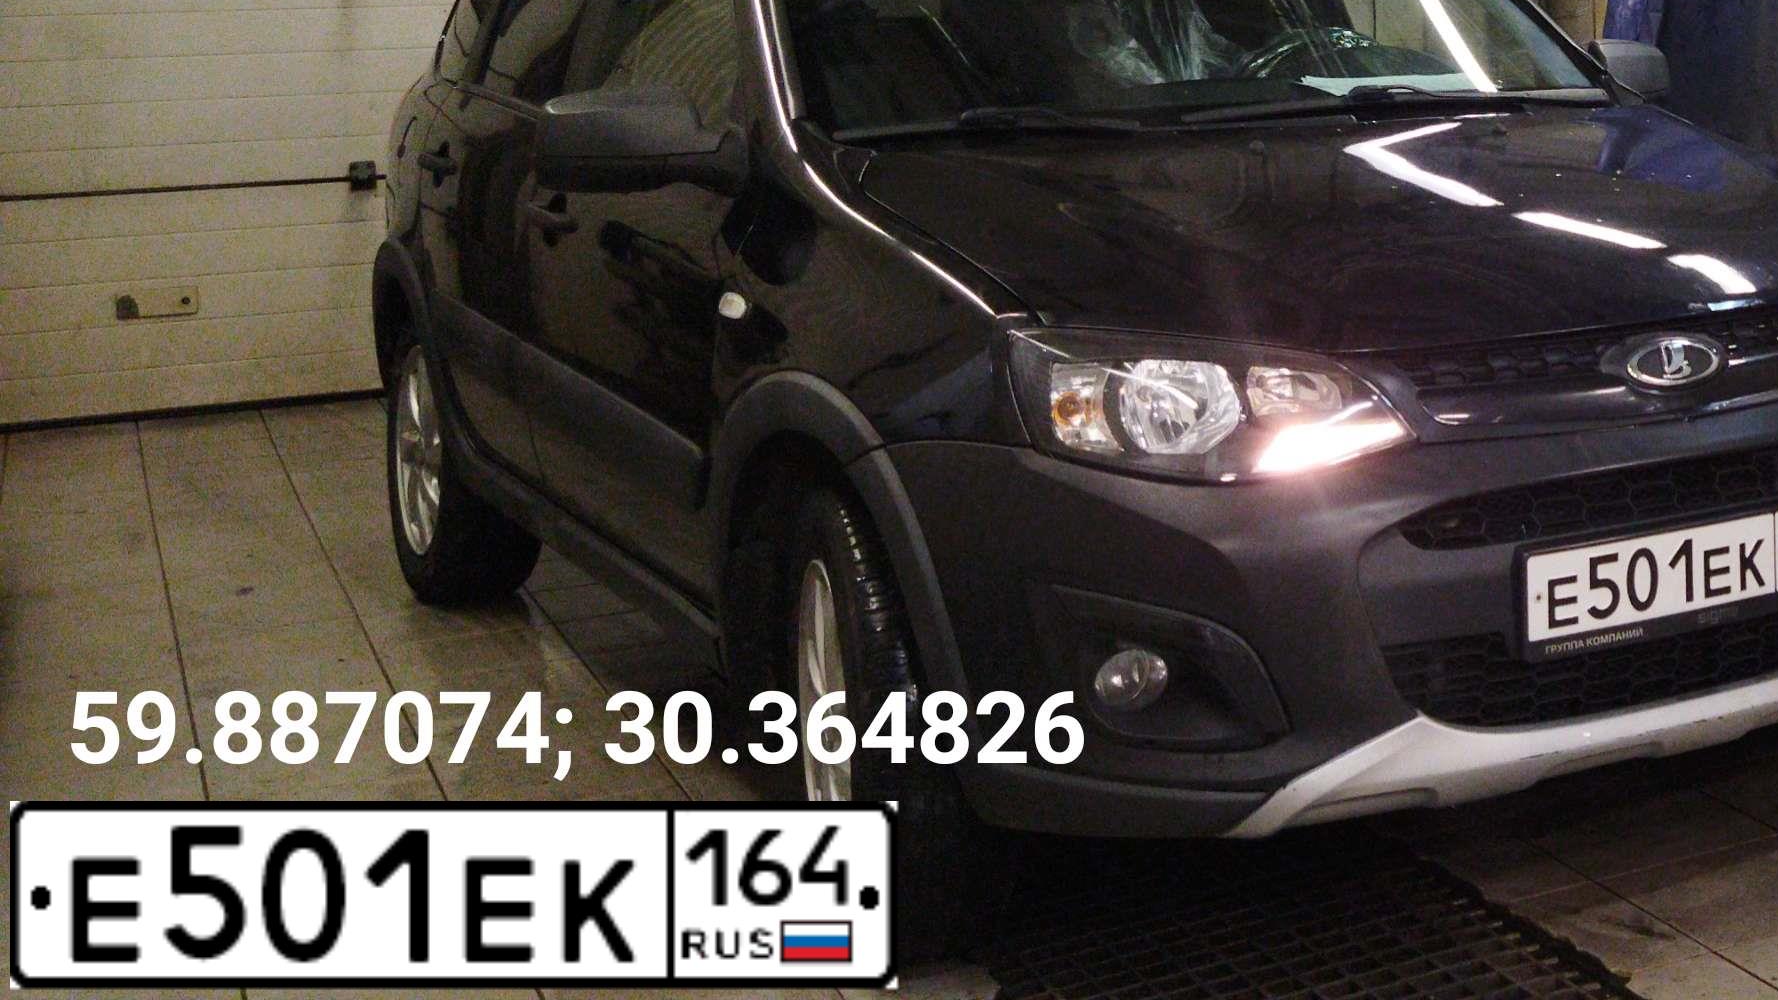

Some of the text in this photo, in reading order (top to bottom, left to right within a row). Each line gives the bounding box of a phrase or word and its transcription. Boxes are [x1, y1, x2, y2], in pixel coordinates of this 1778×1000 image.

[1547, 539, 1765, 629] Е501ЕК
[1545, 627, 1644, 655] ГРУППА КОМПАНИЙ
